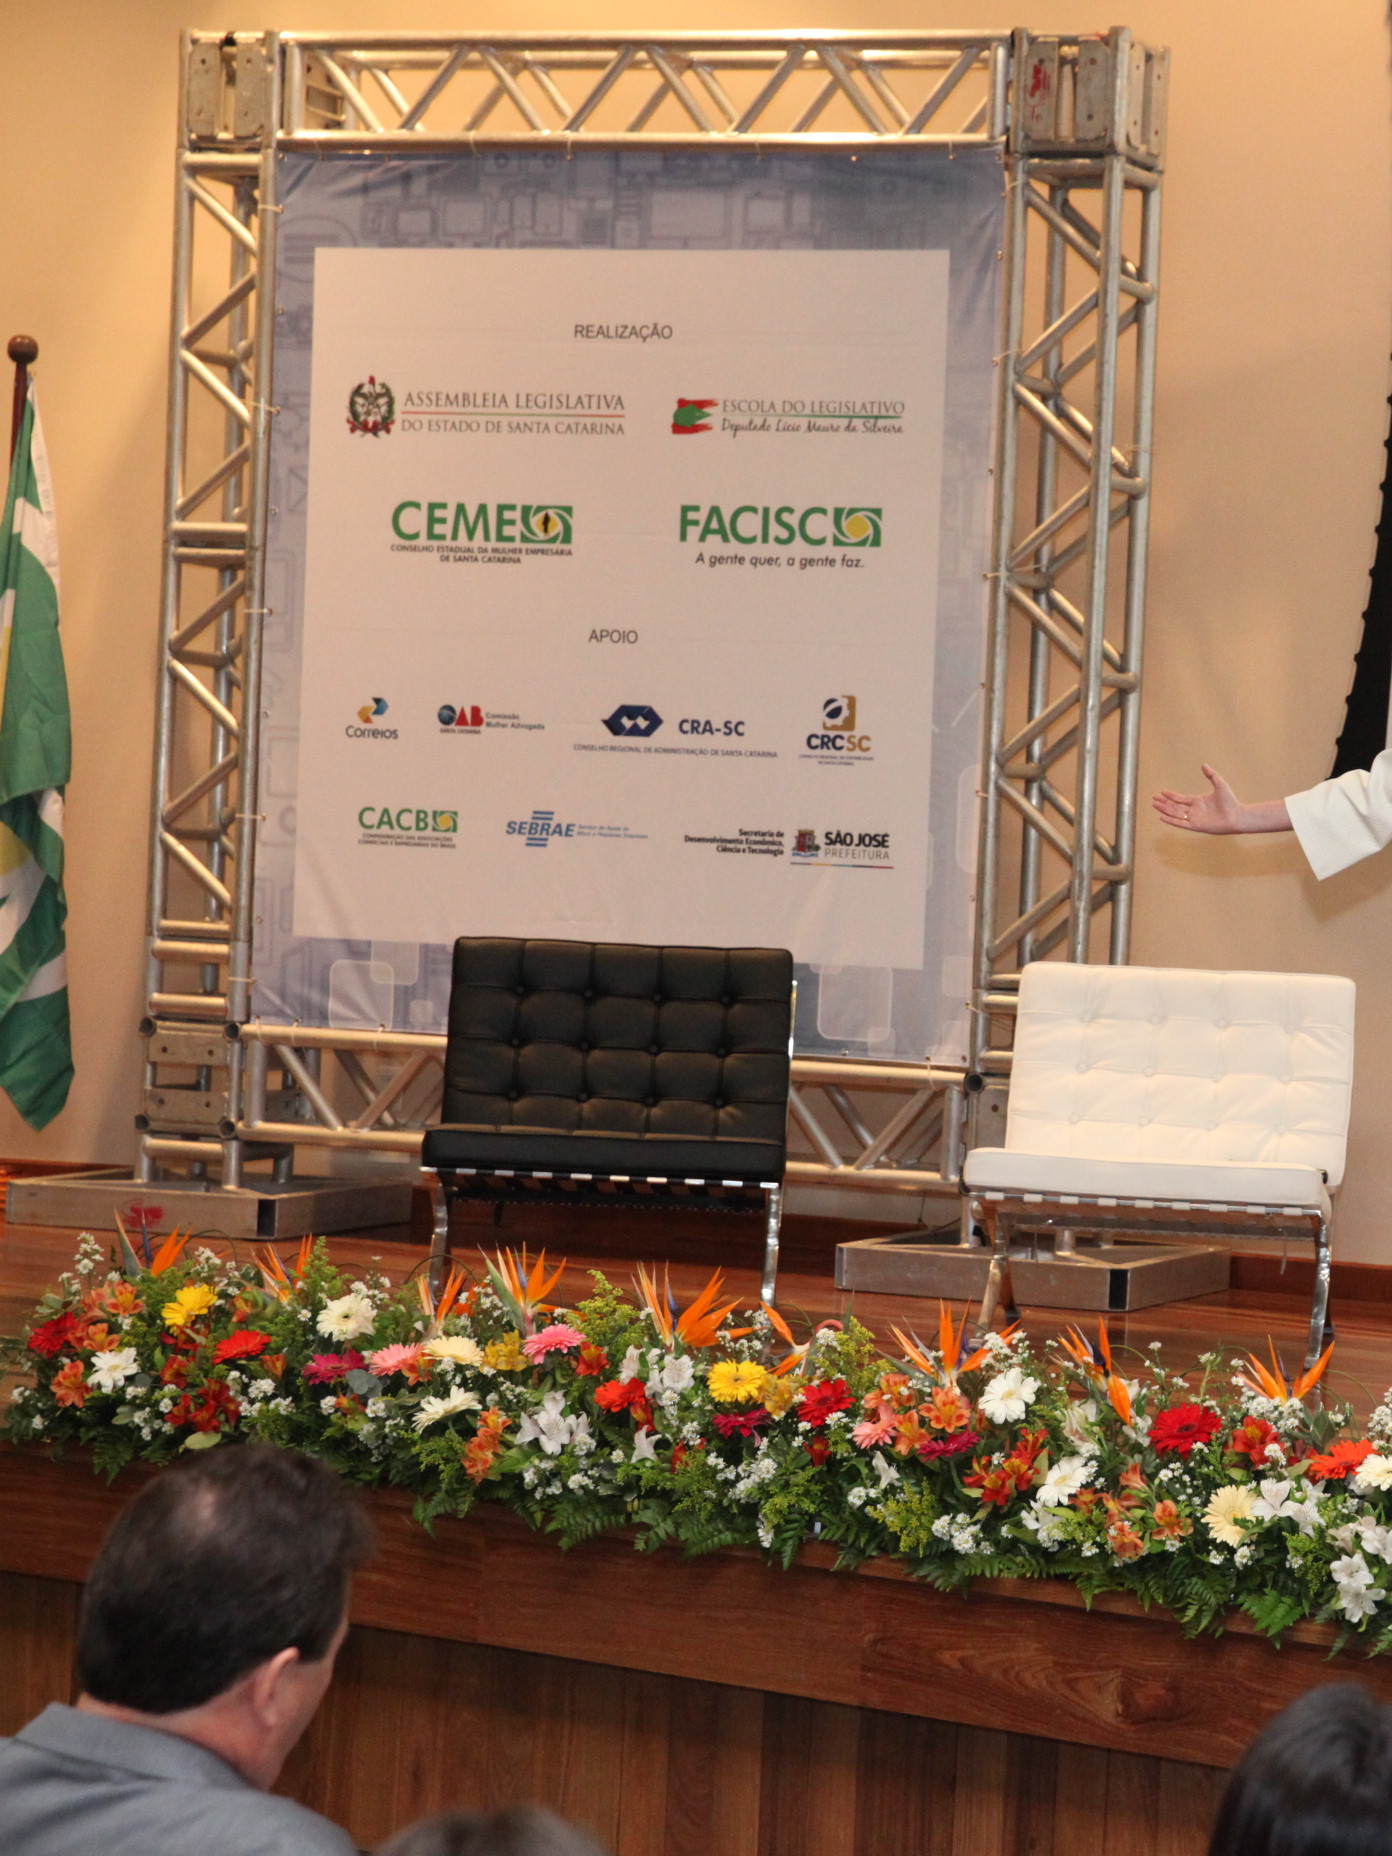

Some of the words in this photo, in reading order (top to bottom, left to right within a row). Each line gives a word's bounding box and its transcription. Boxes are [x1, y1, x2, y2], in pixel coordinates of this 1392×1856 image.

[574, 322, 673, 343] REALIZAÇÃO
[404, 392, 509, 408] ASSEMBLEIA
[515, 393, 626, 410] LEGISLATIVA
[722, 399, 777, 413] ESCOLA
[782, 400, 805, 414] DO
[810, 400, 905, 415] LEGISLATIVO
[401, 419, 422, 432] DO
[427, 419, 480, 433] ESTADO
[485, 420, 502, 434] DE
[507, 421, 551, 434] SANTA
[555, 422, 625, 436] CATARINA
[803, 418, 840, 434] Mauro
[844, 419, 859, 433] da
[862, 416, 904, 434] Silveira
[680, 505, 828, 546] FACISC
[391, 544, 434, 553] CONSELHO
[436, 545, 475, 554] ESTADUAL
[478, 546, 488, 554] DA
[491, 547, 522, 556] MULHER
[453, 555, 479, 563] SANTA
[481, 556, 522, 564] CATARINA
[694, 552, 705, 564] A
[709, 553, 746, 568] gente
[750, 555, 781, 569] quer,
[787, 557, 795, 566] a
[800, 555, 836, 570] gente
[841, 554, 865, 568] faz.
[588, 628, 639, 644] APOIO
[345, 725, 399, 740] Correios
[485, 720, 509, 729] Mulher
[510, 722, 545, 731] Advogada
[678, 719, 745, 736] CRA-SC
[573, 744, 608, 752] CONSELHO
[610, 744, 642, 753] REGIONAL
[644, 746, 653, 754] DE
[710, 748, 719, 756] DE
[721, 749, 743, 757] SANTA
[744, 750, 778, 758] CATARINA
[358, 806, 429, 831] CACB
[505, 820, 576, 838] SEBRAE
[738, 829, 773, 838] Secretaria
[775, 830, 784, 838] de
[684, 835, 744, 845] Desenvolvimento
[824, 830, 853, 847] SÃO
[855, 832, 890, 848] JOSÉ
[716, 844, 741, 854] Ciência
[748, 846, 784, 857] Tecnologia
[824, 848, 890, 860] PREFEITURA
